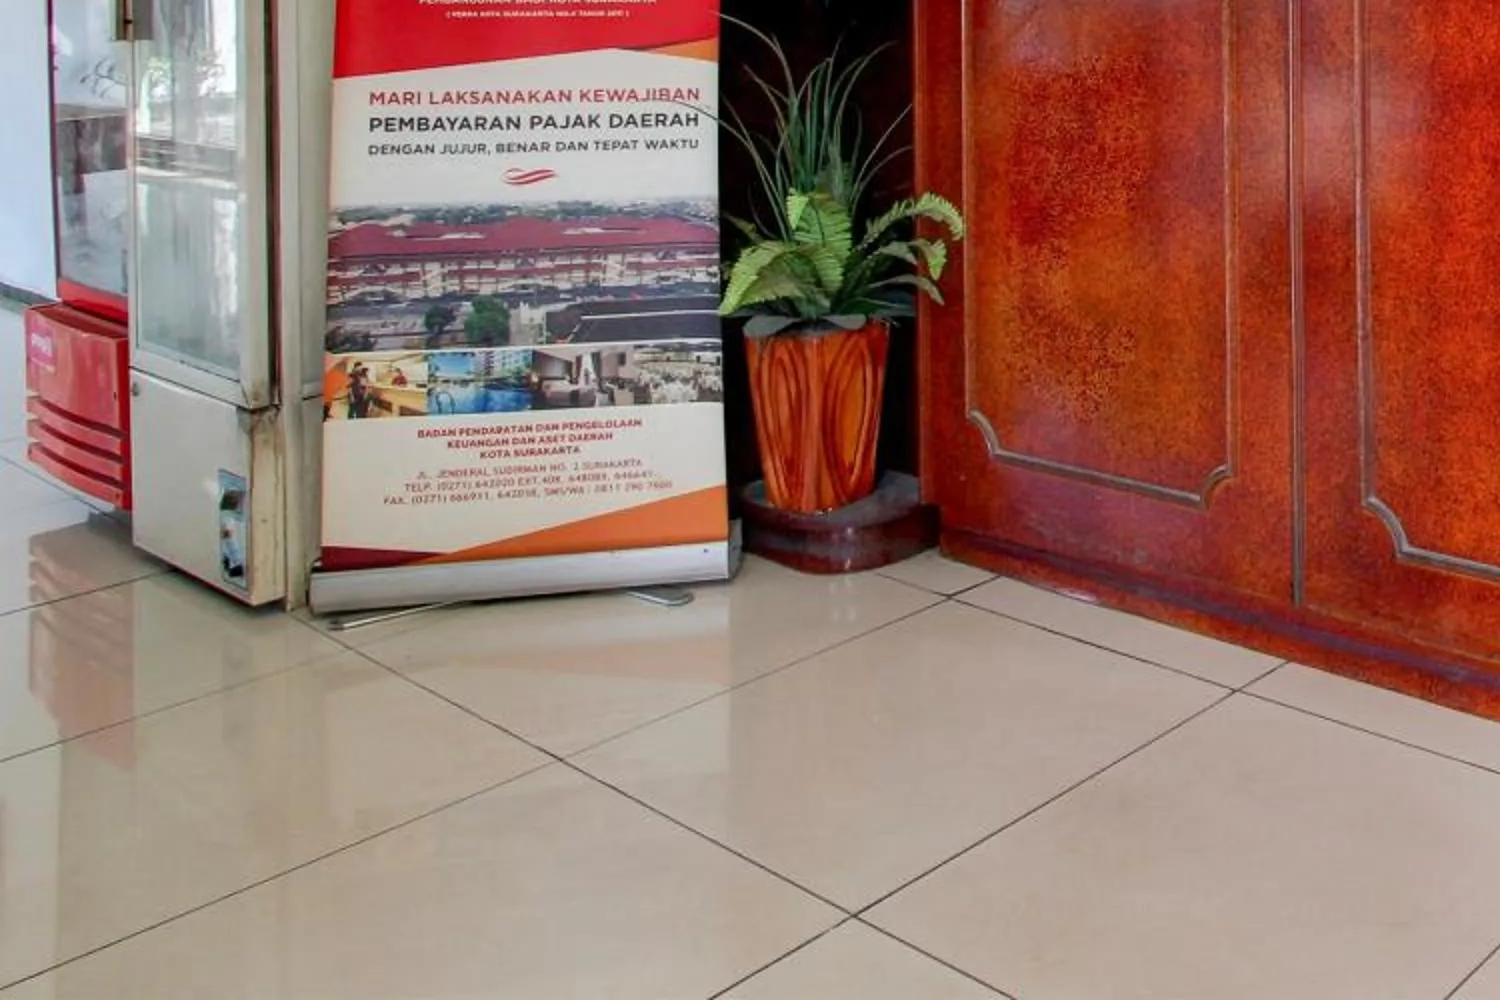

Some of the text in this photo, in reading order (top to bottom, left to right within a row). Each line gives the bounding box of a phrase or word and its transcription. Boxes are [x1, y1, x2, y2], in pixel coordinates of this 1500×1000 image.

[369, 87, 700, 105] MARI LAKSANAKAN KEWAJIBAN
[369, 112, 699, 132] PEMBAYARAN PAJAK DAERAH
[368, 138, 700, 156] DENGAN JUJUR, BENAR DAN TEPAT WAKTU
[417, 418, 643, 439] BADAN PENDAPATAN DAN PENGELOLAAN
[447, 432, 613, 449] KEUANGAN DAN ASET DAERAH
[480, 444, 581, 460] KOTA SURAKARTA
[437, 467, 491, 479] JENDERAL
[493, 462, 547, 475] SUDIRMAN
